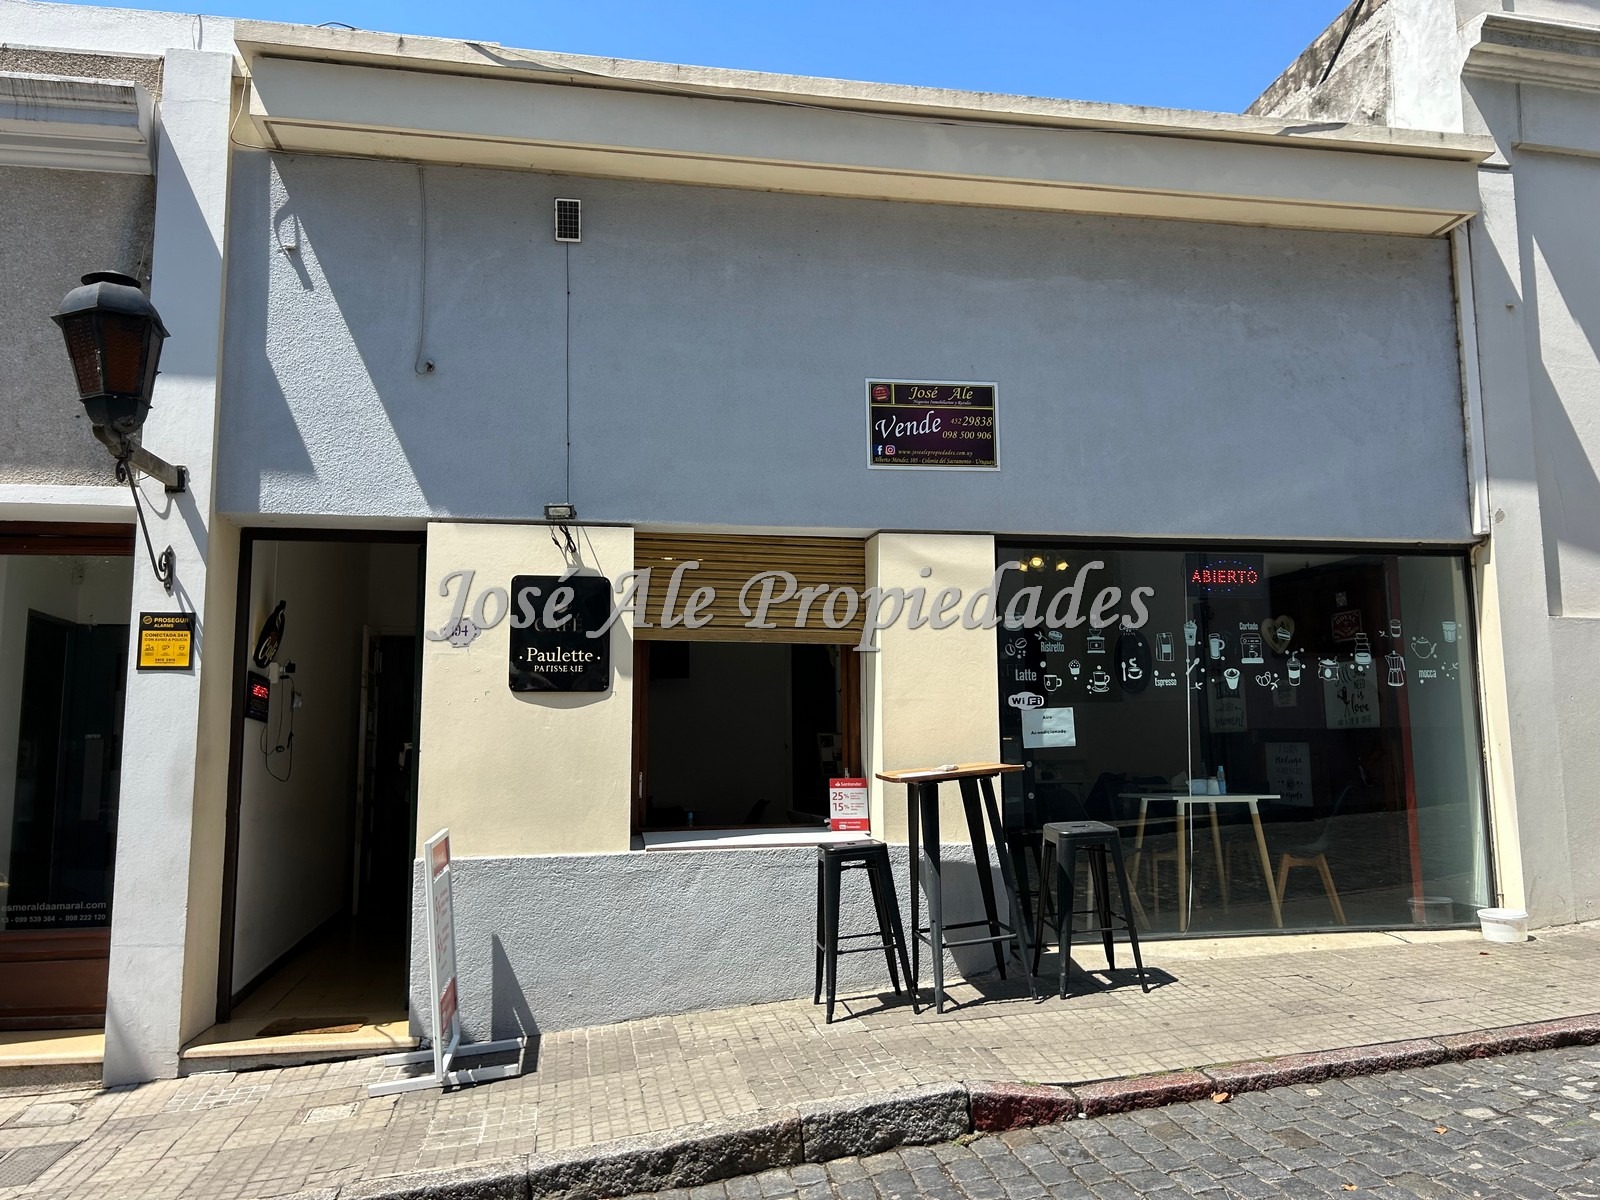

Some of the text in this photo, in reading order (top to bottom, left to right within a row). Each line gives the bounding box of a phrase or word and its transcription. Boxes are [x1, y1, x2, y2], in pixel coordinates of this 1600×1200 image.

[908, 386, 974, 400] José Ale
[875, 410, 942, 438] Vende
[962, 416, 992, 426] 29838
[942, 430, 992, 440] 098 500 906
[1192, 570, 1258, 584] ABIERTO
[1040, 642, 1064, 652] Ristretto
[526, 647, 594, 662] Paulette
[1016, 669, 1037, 681] Latte
[1154, 678, 1177, 686] Espresso
